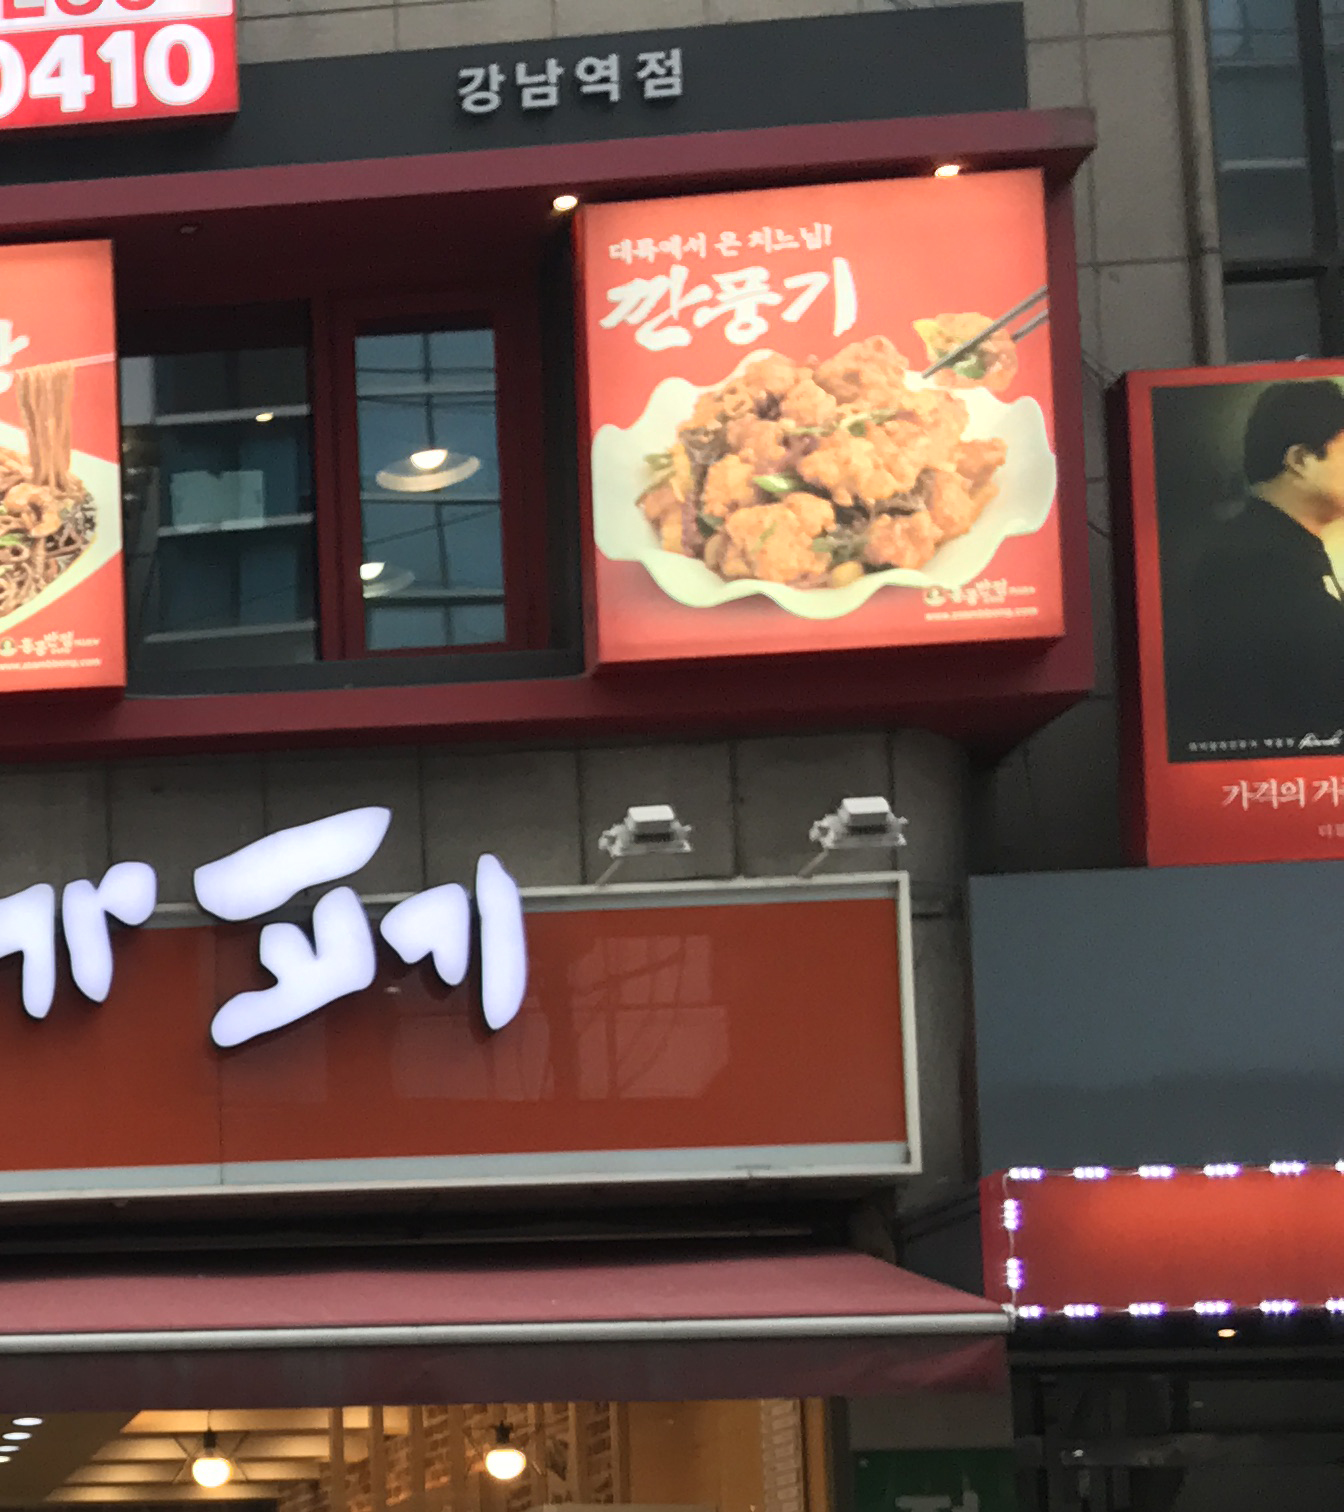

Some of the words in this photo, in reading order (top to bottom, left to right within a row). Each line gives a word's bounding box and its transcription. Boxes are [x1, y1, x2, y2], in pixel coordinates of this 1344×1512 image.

[457, 47, 684, 114] 강남역점
[608, 231, 707, 265] 대륙에서
[714, 231, 743, 257] 온
[747, 221, 833, 253] 치느님!
[598, 256, 858, 352] 깐풍기
[1221, 777, 1306, 812] 가격의
